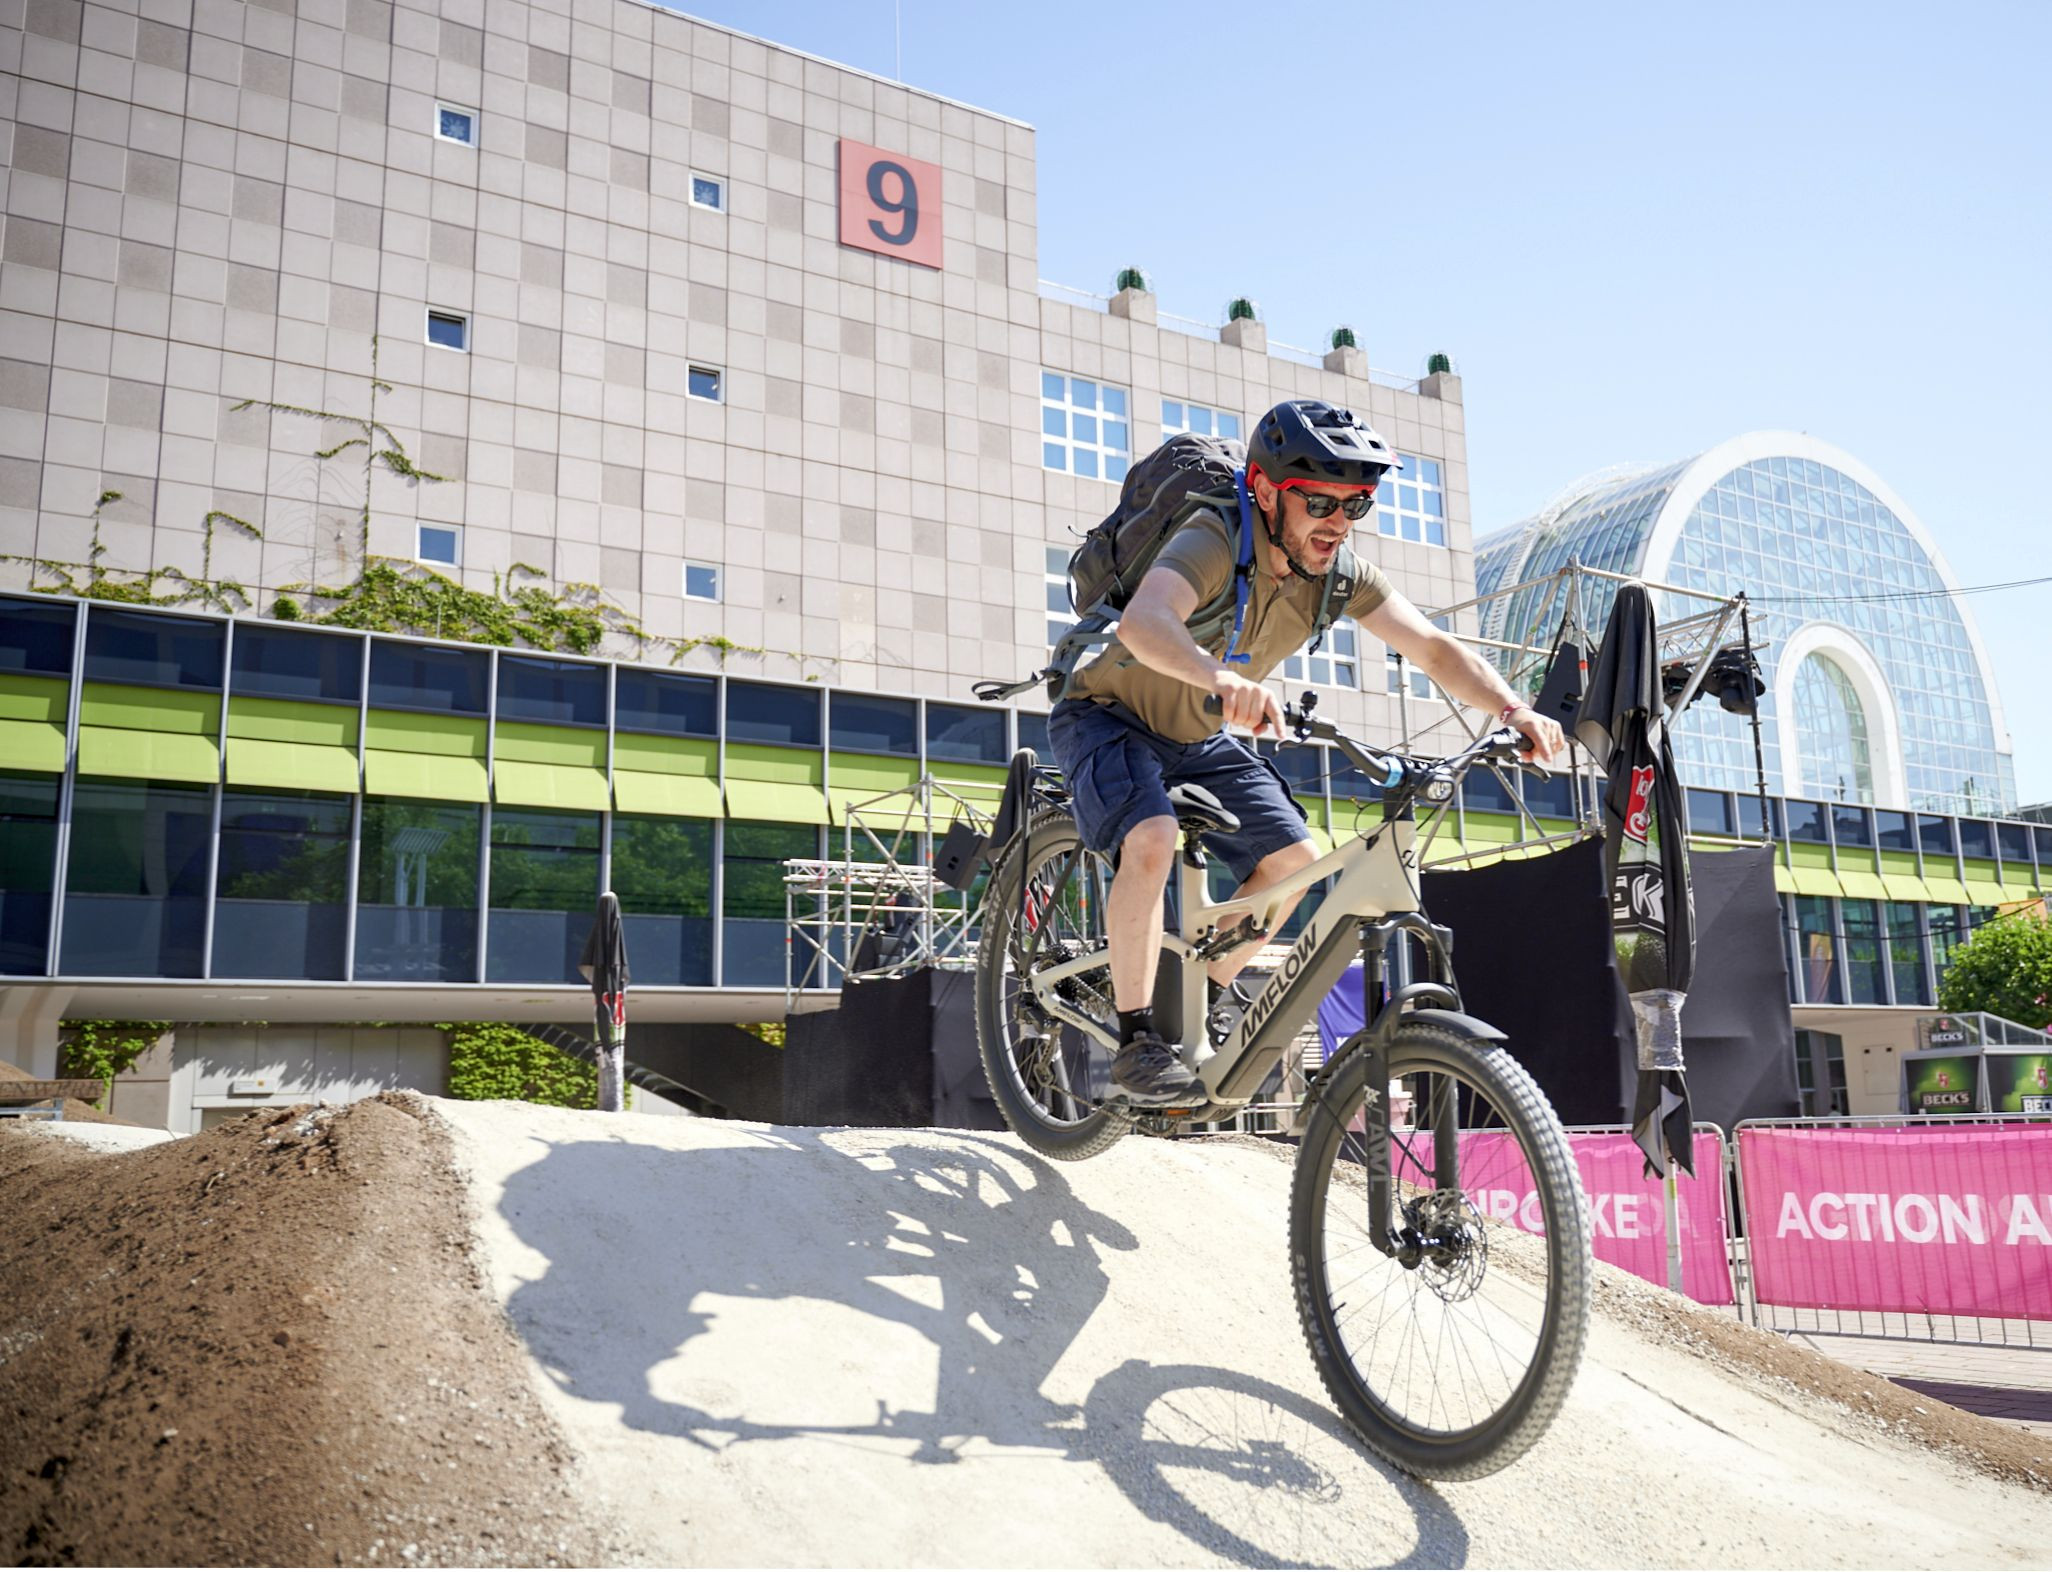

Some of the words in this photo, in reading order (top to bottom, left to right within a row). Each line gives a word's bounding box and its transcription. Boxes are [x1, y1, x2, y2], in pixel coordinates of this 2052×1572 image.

[866, 160, 919, 246] 9
[1241, 923, 1317, 1048] AMFLOW
[1922, 1091, 1970, 1106] BECK'S
[1776, 1191, 1985, 1245] ACTION
